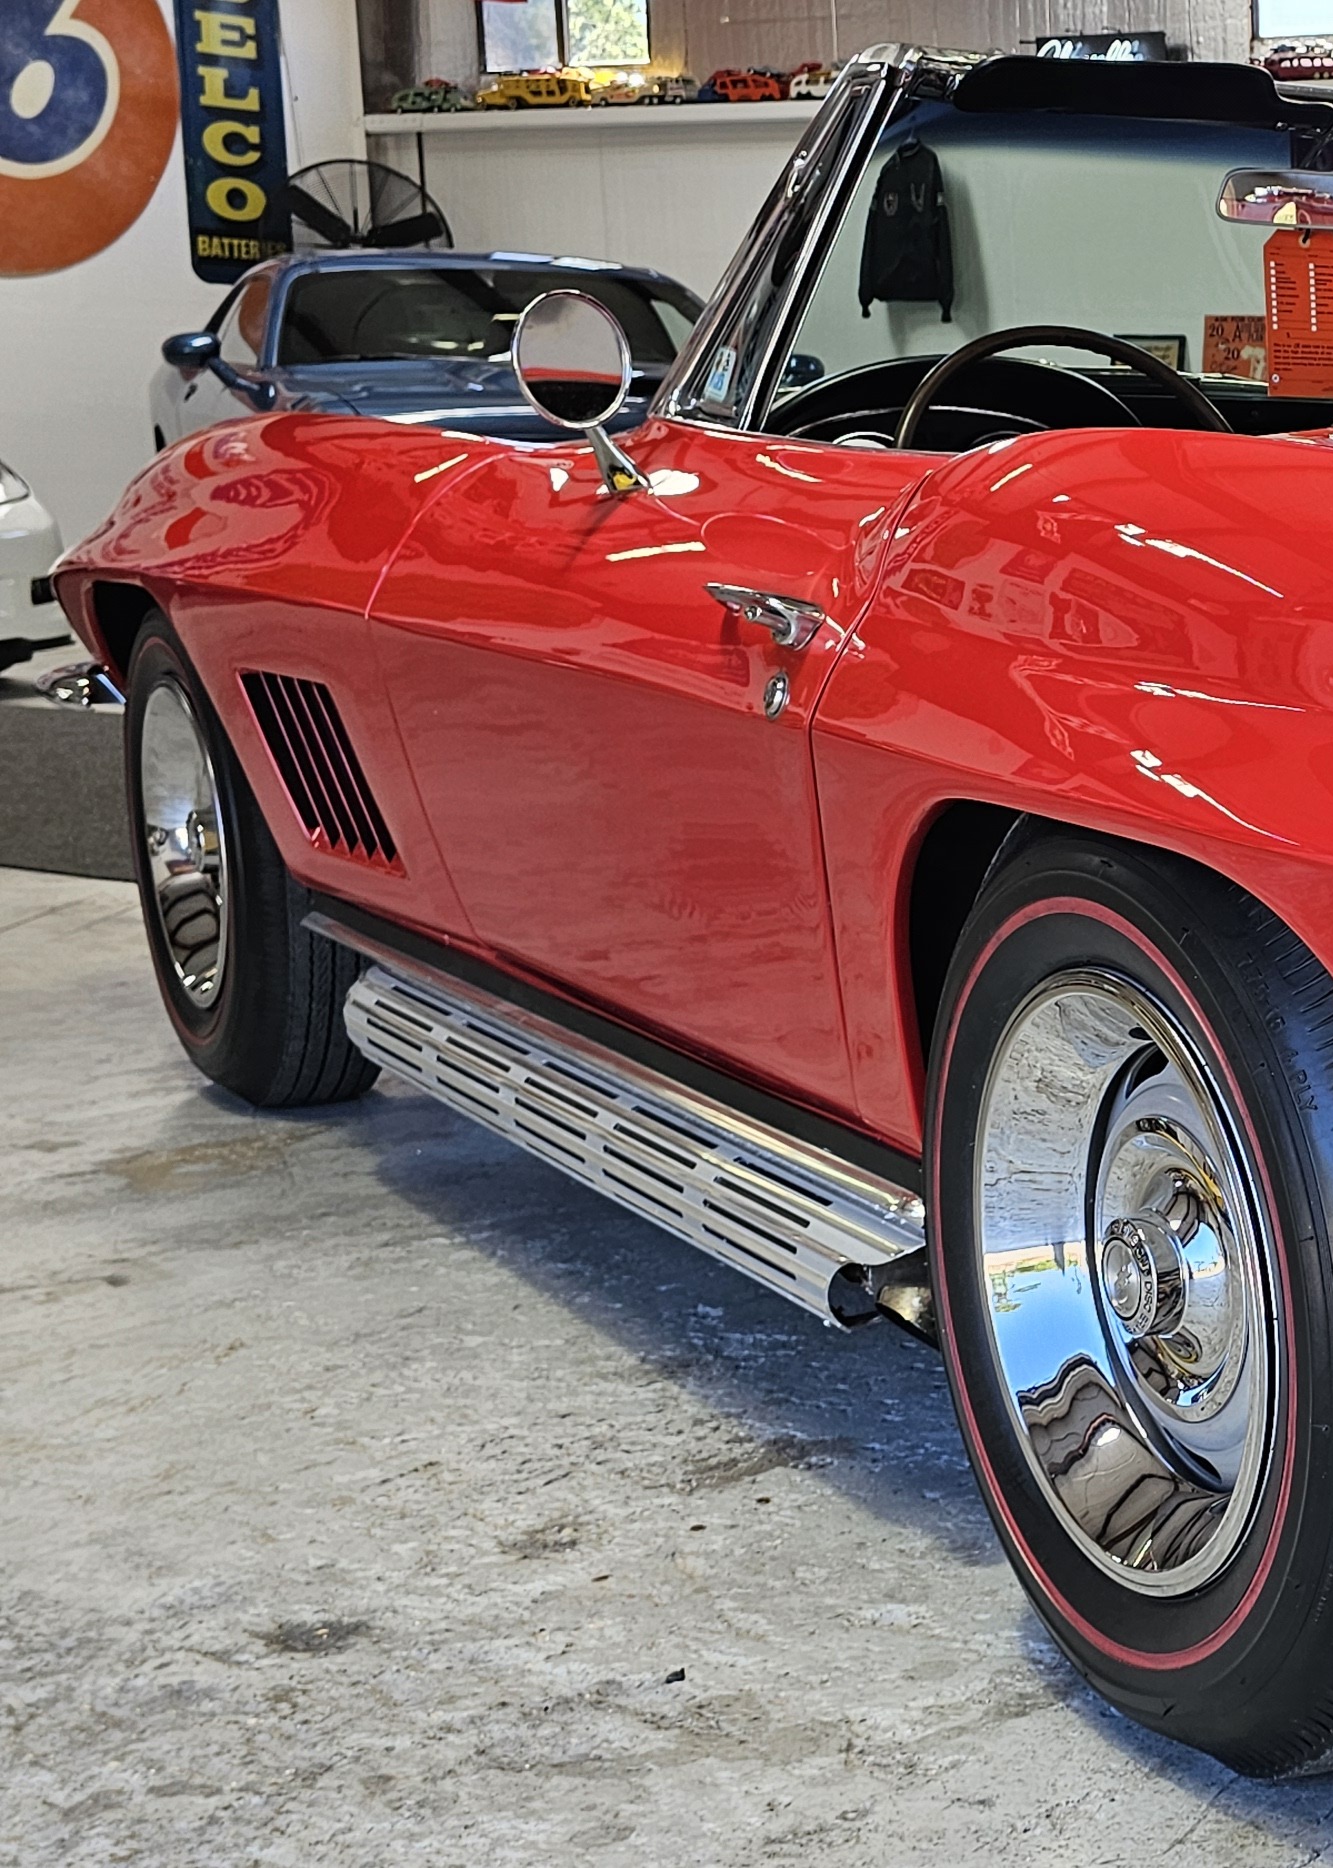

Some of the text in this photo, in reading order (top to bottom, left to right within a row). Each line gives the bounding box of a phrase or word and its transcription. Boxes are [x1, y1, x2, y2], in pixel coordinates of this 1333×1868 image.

[194, 0, 266, 222] ELCO
[1208, 322, 1225, 338] 20
[1223, 346, 1240, 361] 20
[1289, 1068, 1320, 1112] PLY
